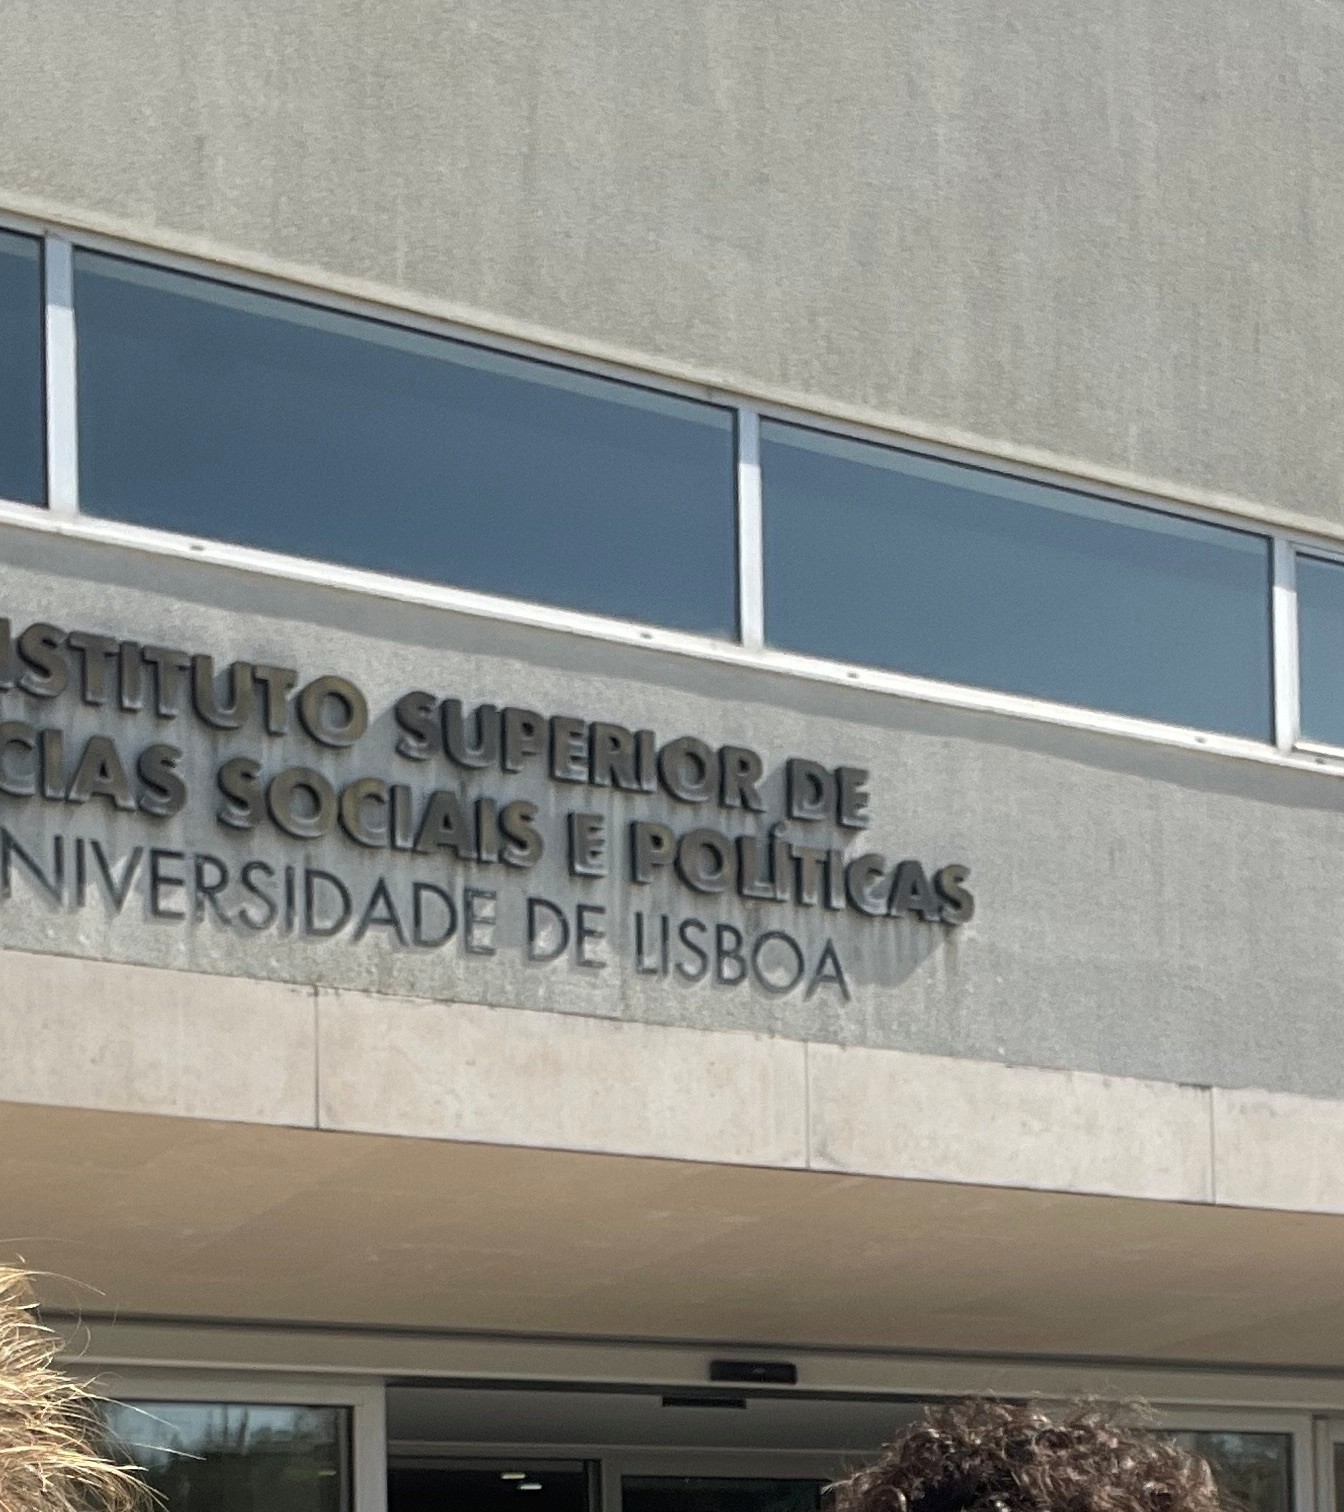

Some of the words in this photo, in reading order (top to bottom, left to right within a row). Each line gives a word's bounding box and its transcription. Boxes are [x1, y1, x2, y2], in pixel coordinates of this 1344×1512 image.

[394, 690, 766, 813] SUPERIOR
[786, 757, 871, 830] DE
[217, 755, 544, 869] SOCIAIS
[567, 811, 609, 878] E
[629, 818, 975, 926] POLÍTICAS
[527, 896, 608, 968] DE
[635, 911, 853, 1001] LISBOA
